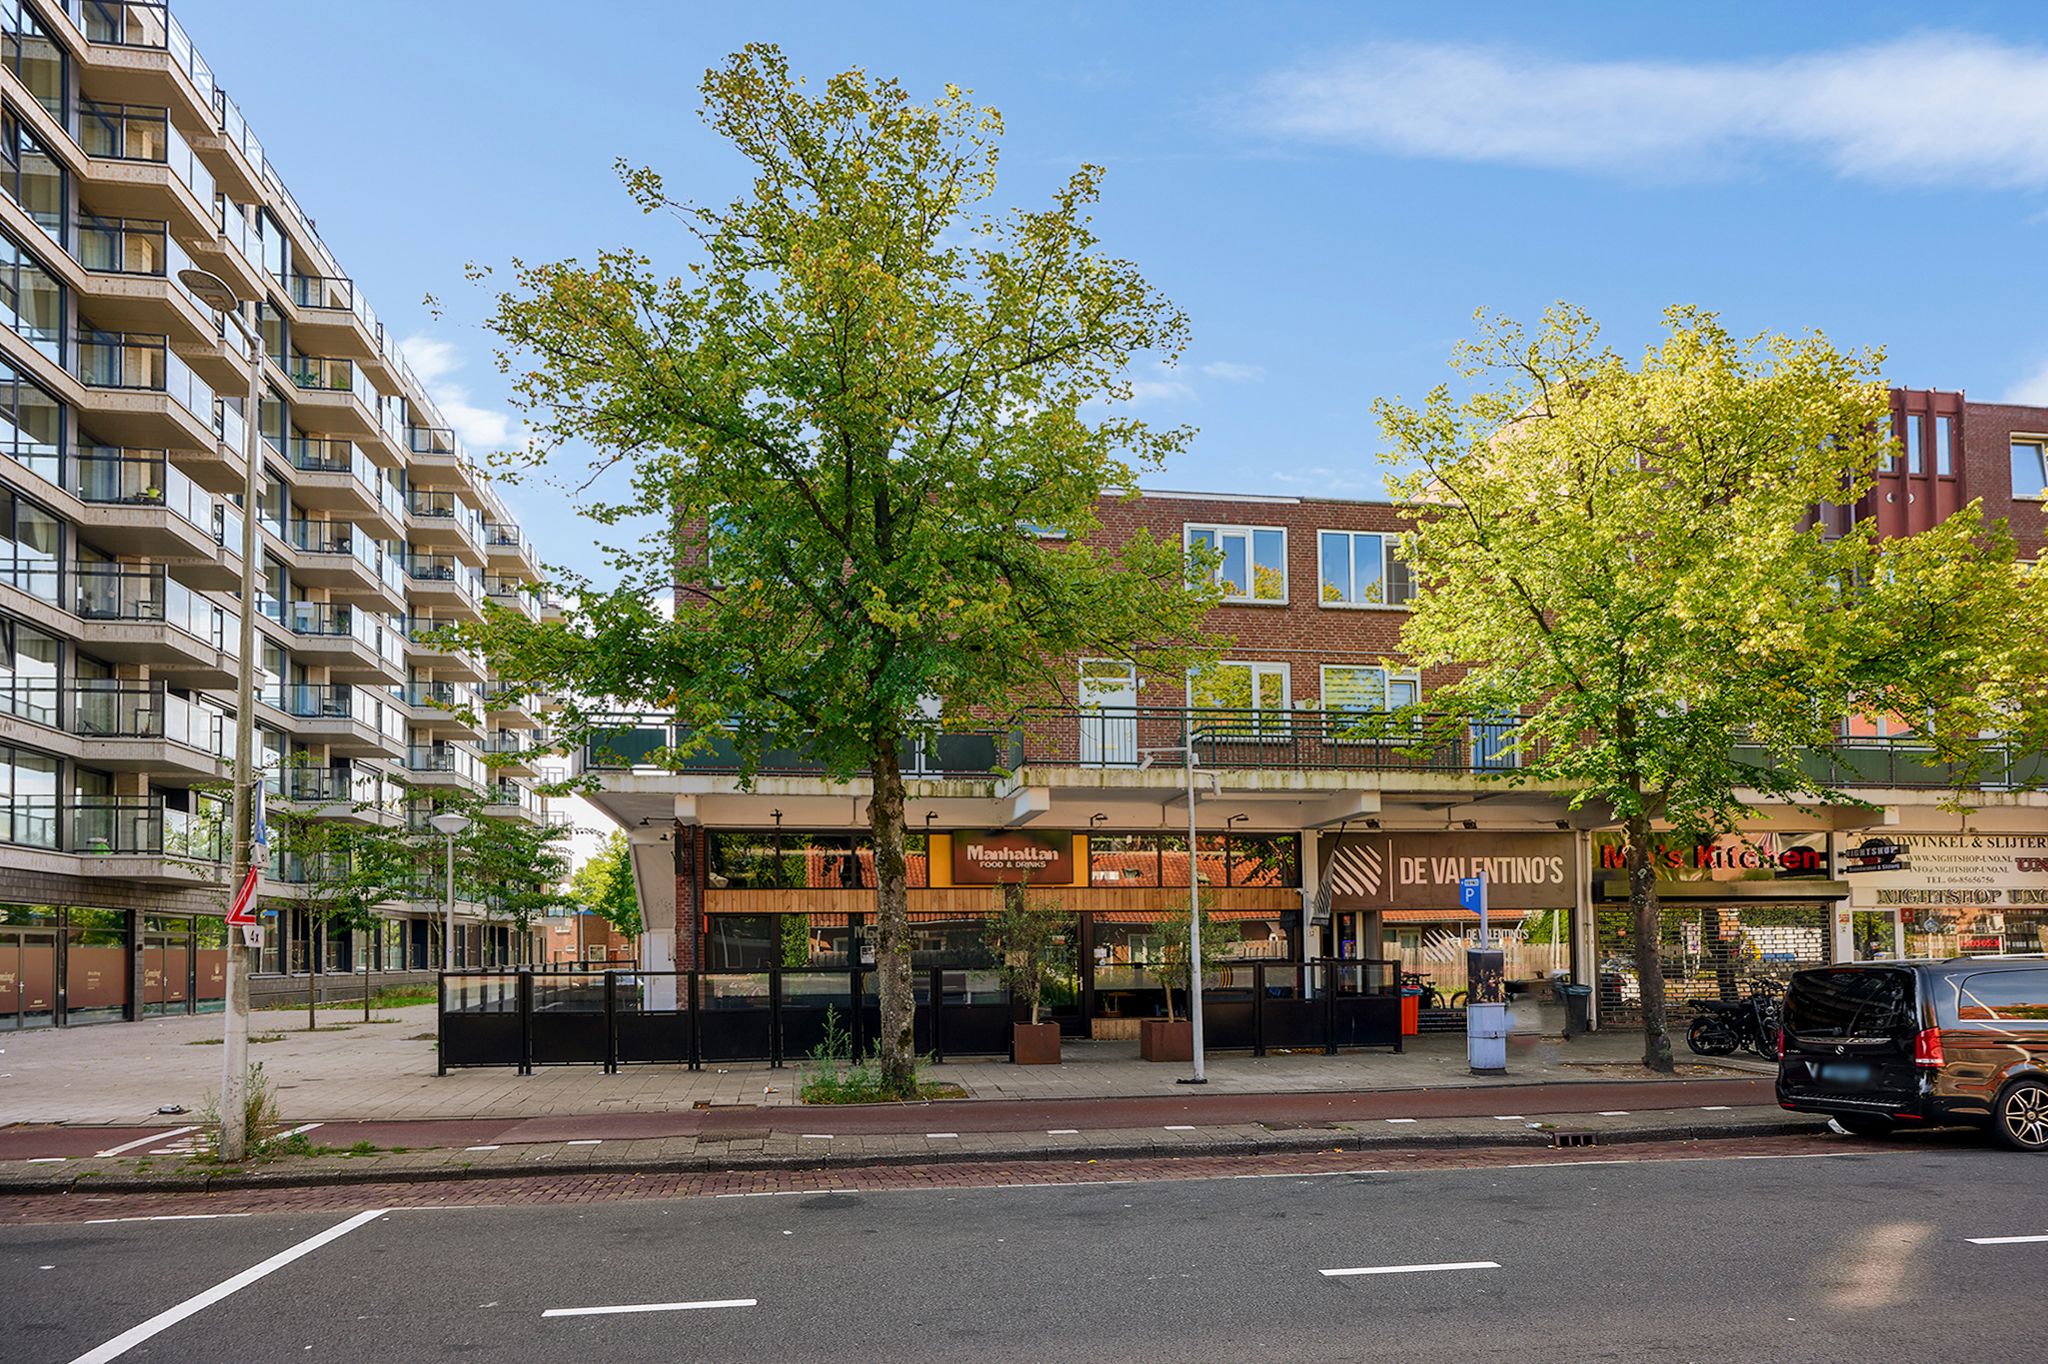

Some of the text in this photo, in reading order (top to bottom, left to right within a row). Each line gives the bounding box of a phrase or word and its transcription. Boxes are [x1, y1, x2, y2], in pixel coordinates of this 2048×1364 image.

[1971, 837, 1982, 848] &
[1987, 836, 2048, 848] SLIJTER
[967, 845, 1058, 860] Manhattan
[1694, 845, 1820, 868] Kitchen
[1400, 857, 1427, 884] DE
[1465, 888, 1474, 902] P
[1877, 889, 2002, 904] NIGHTSHOP
